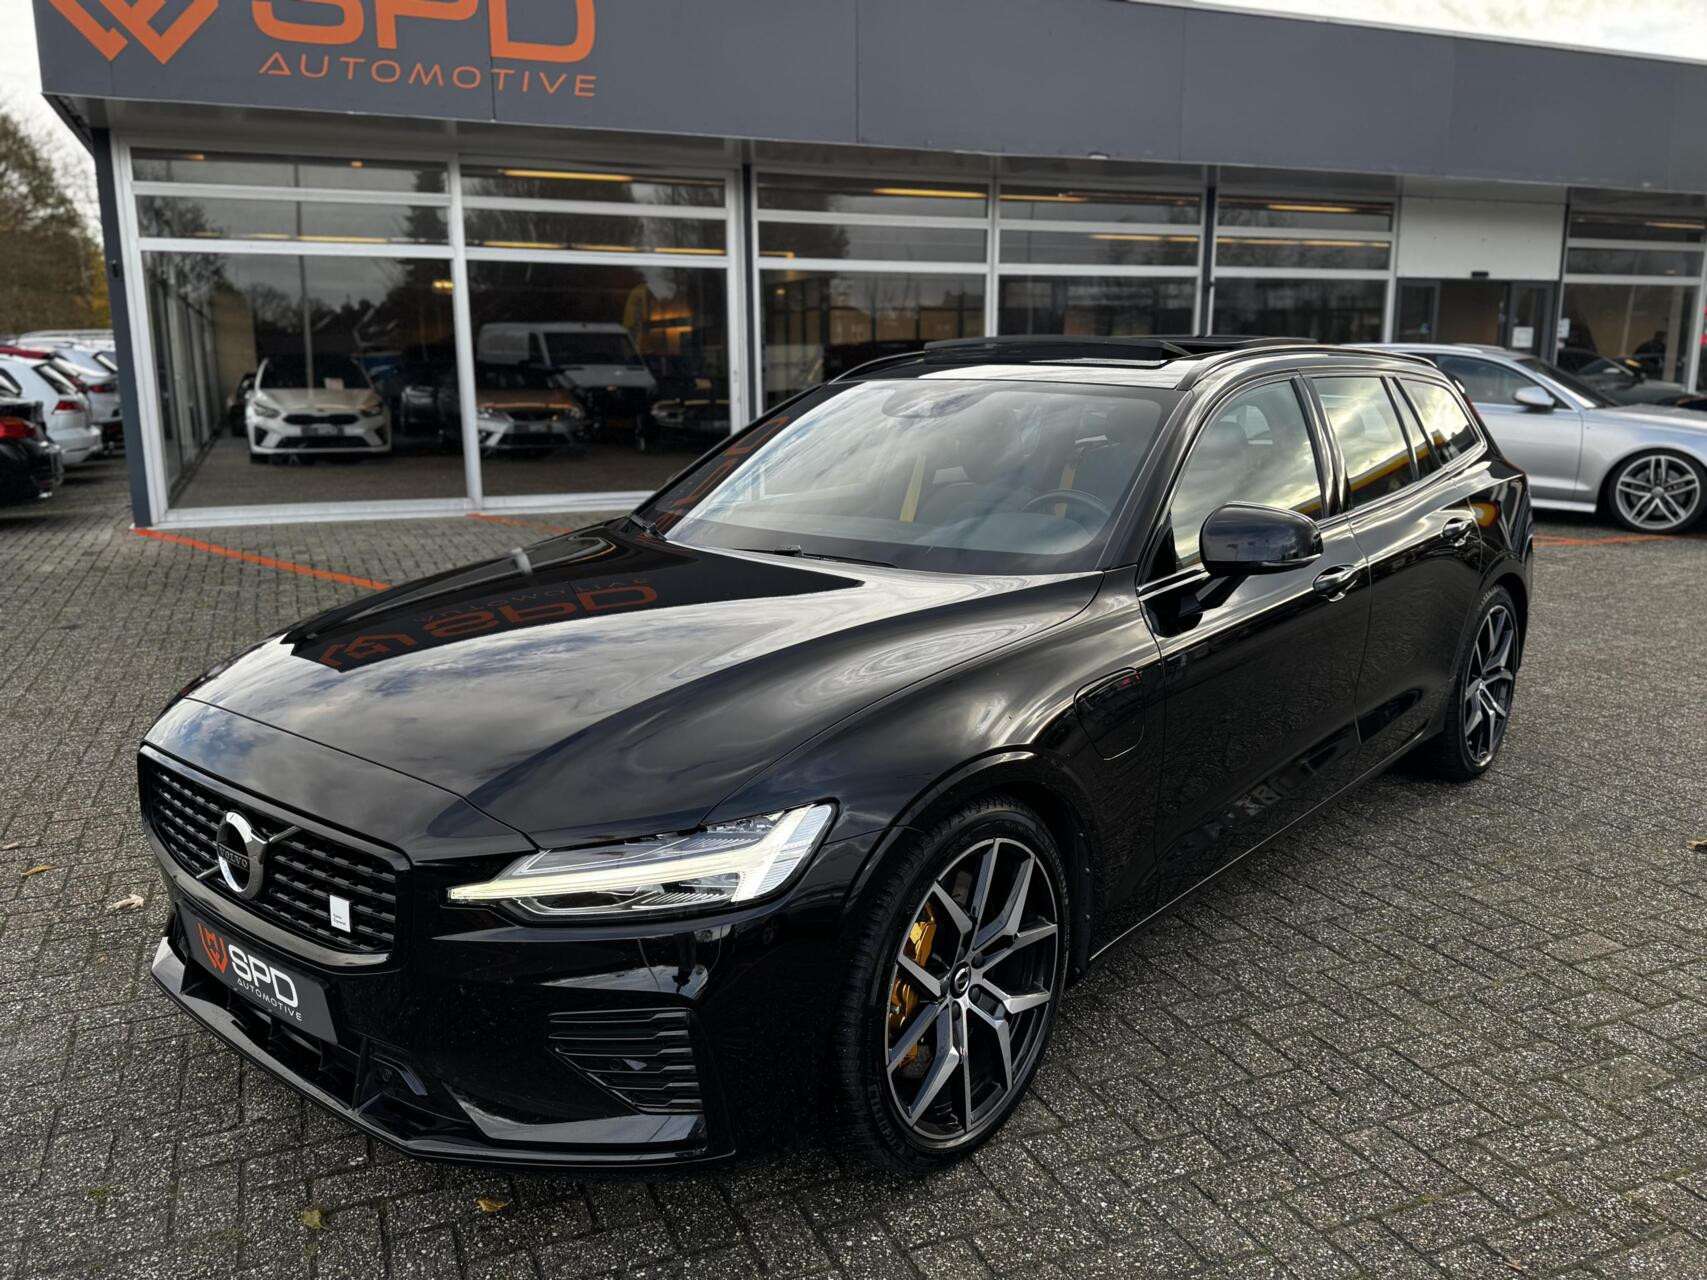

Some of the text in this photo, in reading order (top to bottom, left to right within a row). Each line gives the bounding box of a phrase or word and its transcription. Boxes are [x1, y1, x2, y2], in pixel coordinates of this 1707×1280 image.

[258, 52, 597, 97] AUTOMOTIVE
[218, 846, 248, 868] VOLVO
[229, 945, 299, 1008] SPD
[237, 978, 304, 1022] AUTOMOTIVE
